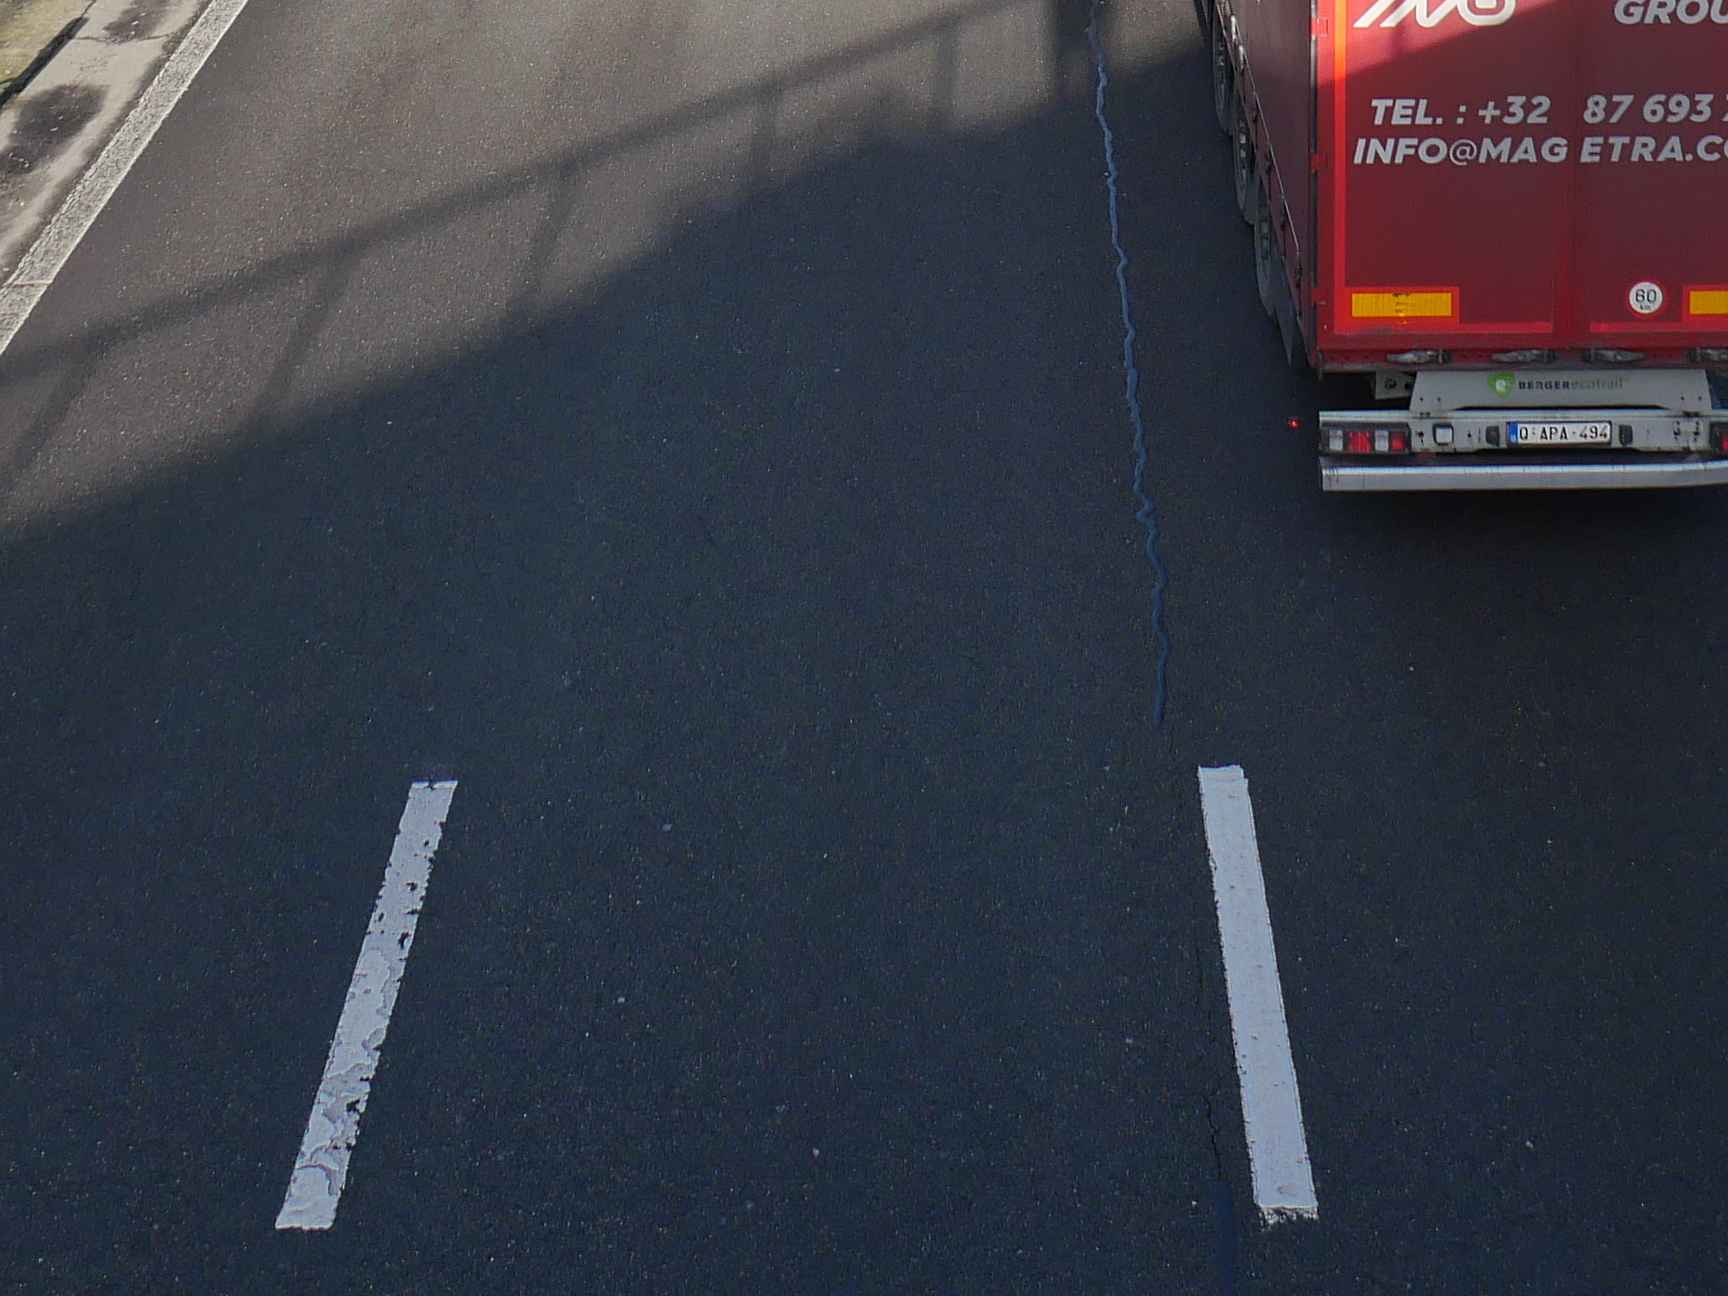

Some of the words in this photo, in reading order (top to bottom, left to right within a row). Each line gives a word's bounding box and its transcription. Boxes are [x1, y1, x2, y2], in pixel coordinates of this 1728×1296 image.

[1370, 97, 1445, 126] TEL.
[1477, 95, 1552, 125] +32
[1583, 94, 1632, 124] 87
[1643, 93, 1713, 124] 693
